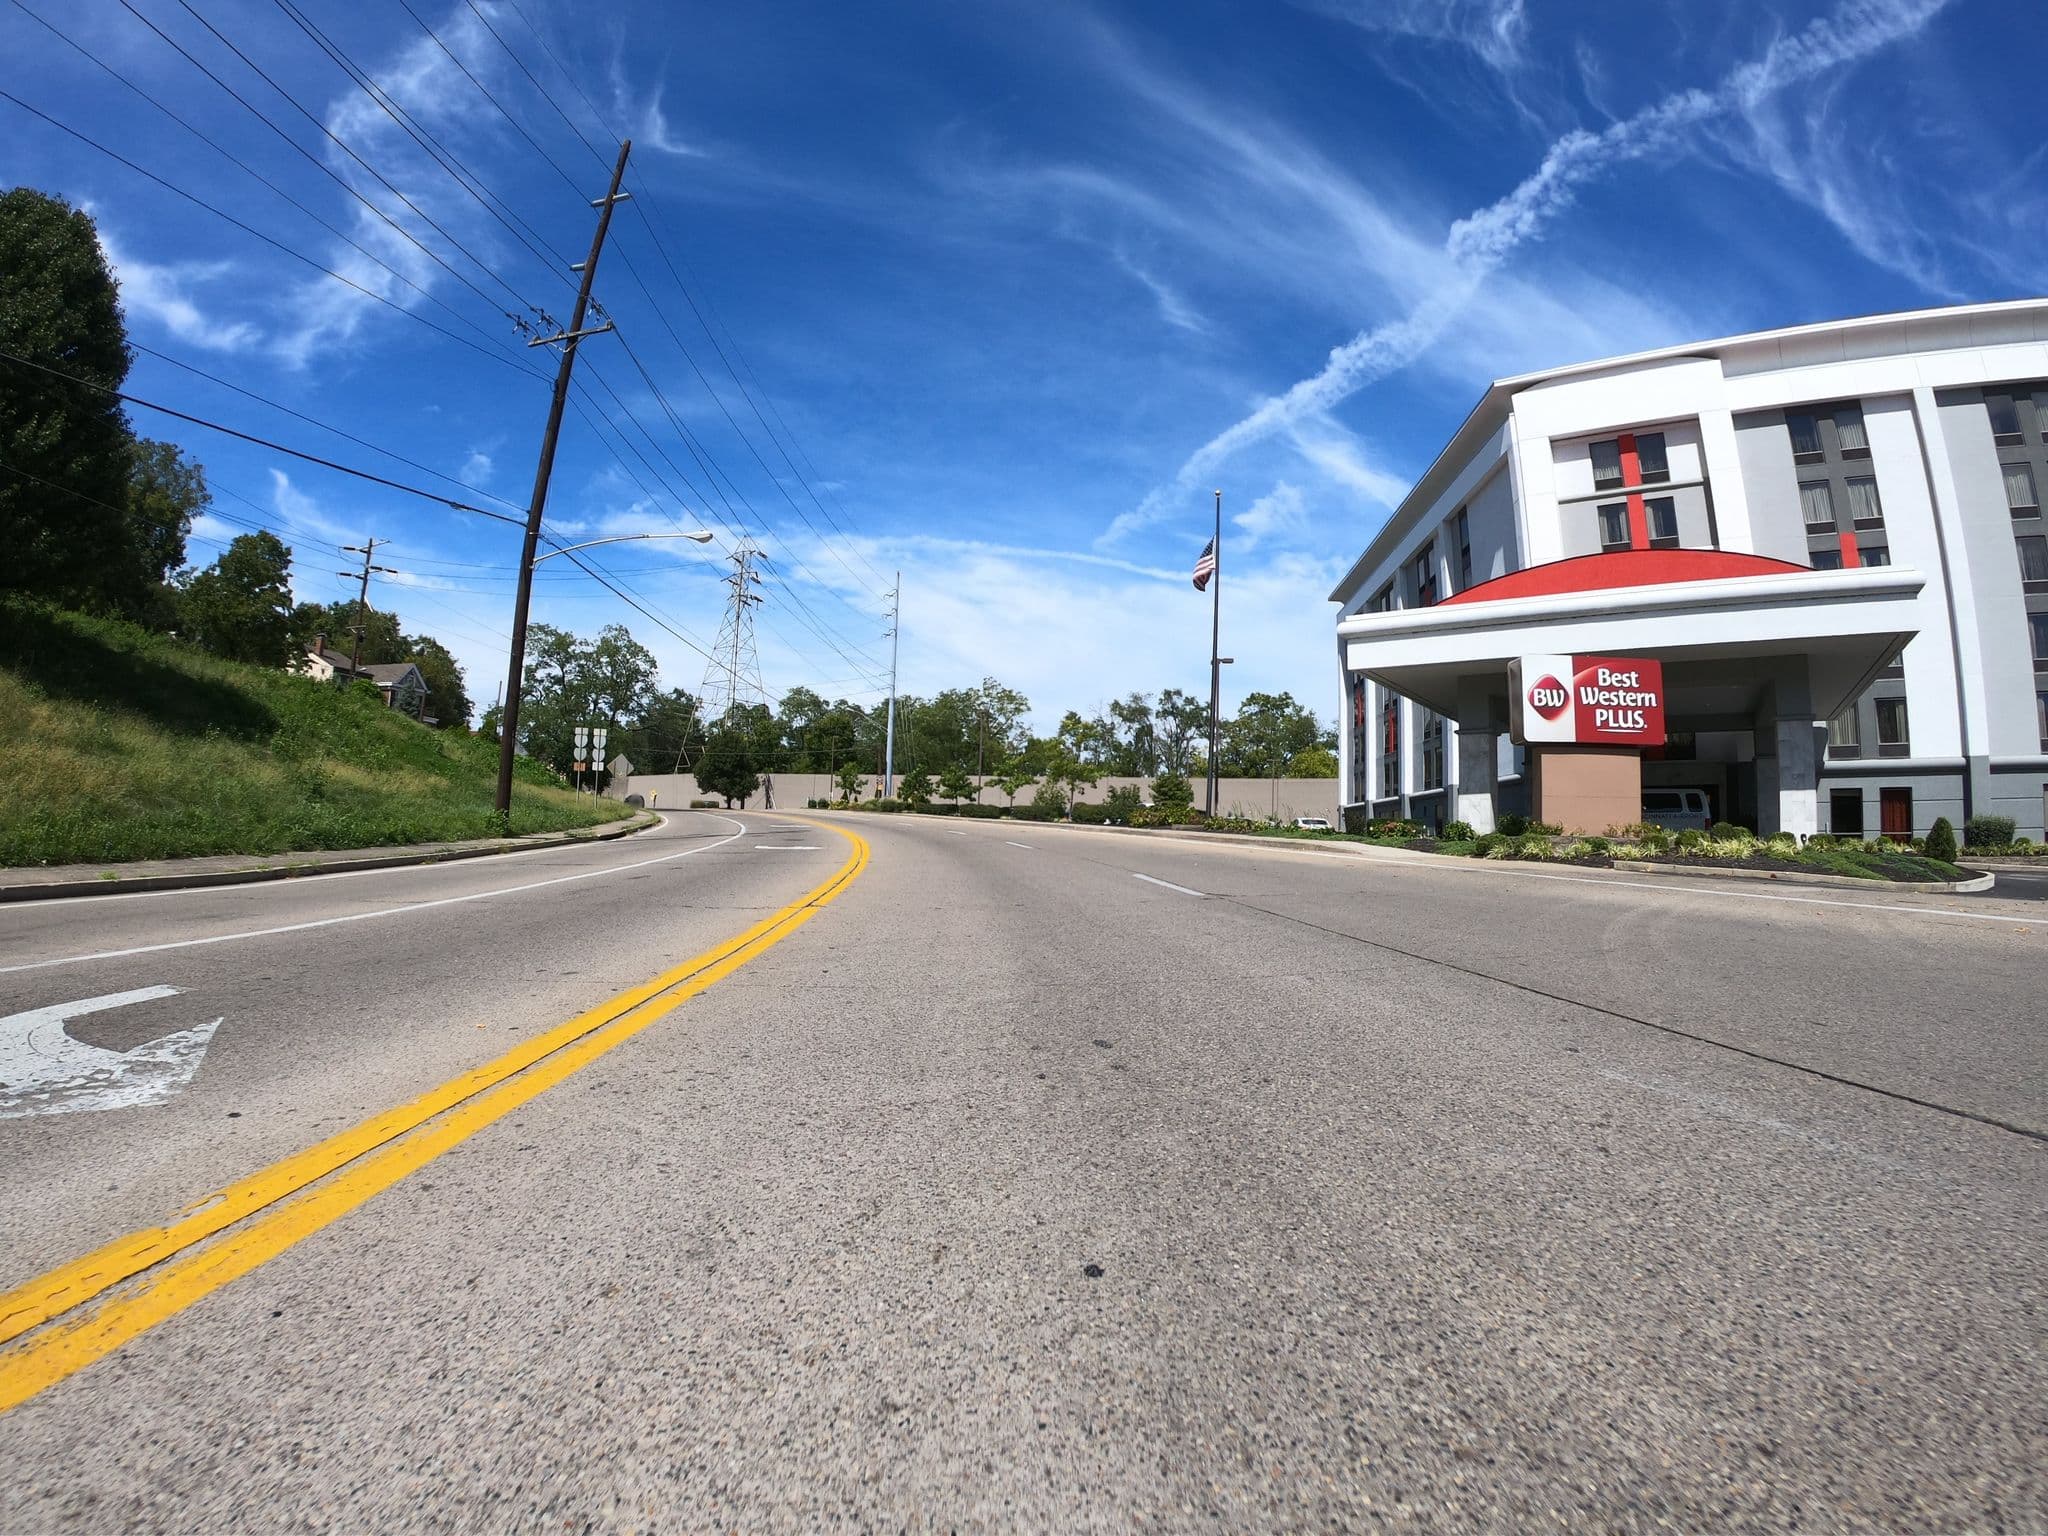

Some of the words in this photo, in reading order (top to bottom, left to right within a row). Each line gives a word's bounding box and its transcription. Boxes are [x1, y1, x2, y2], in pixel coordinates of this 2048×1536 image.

[1597, 668, 1639, 688] Best
[1533, 688, 1565, 708] BW
[1579, 686, 1657, 707] Western
